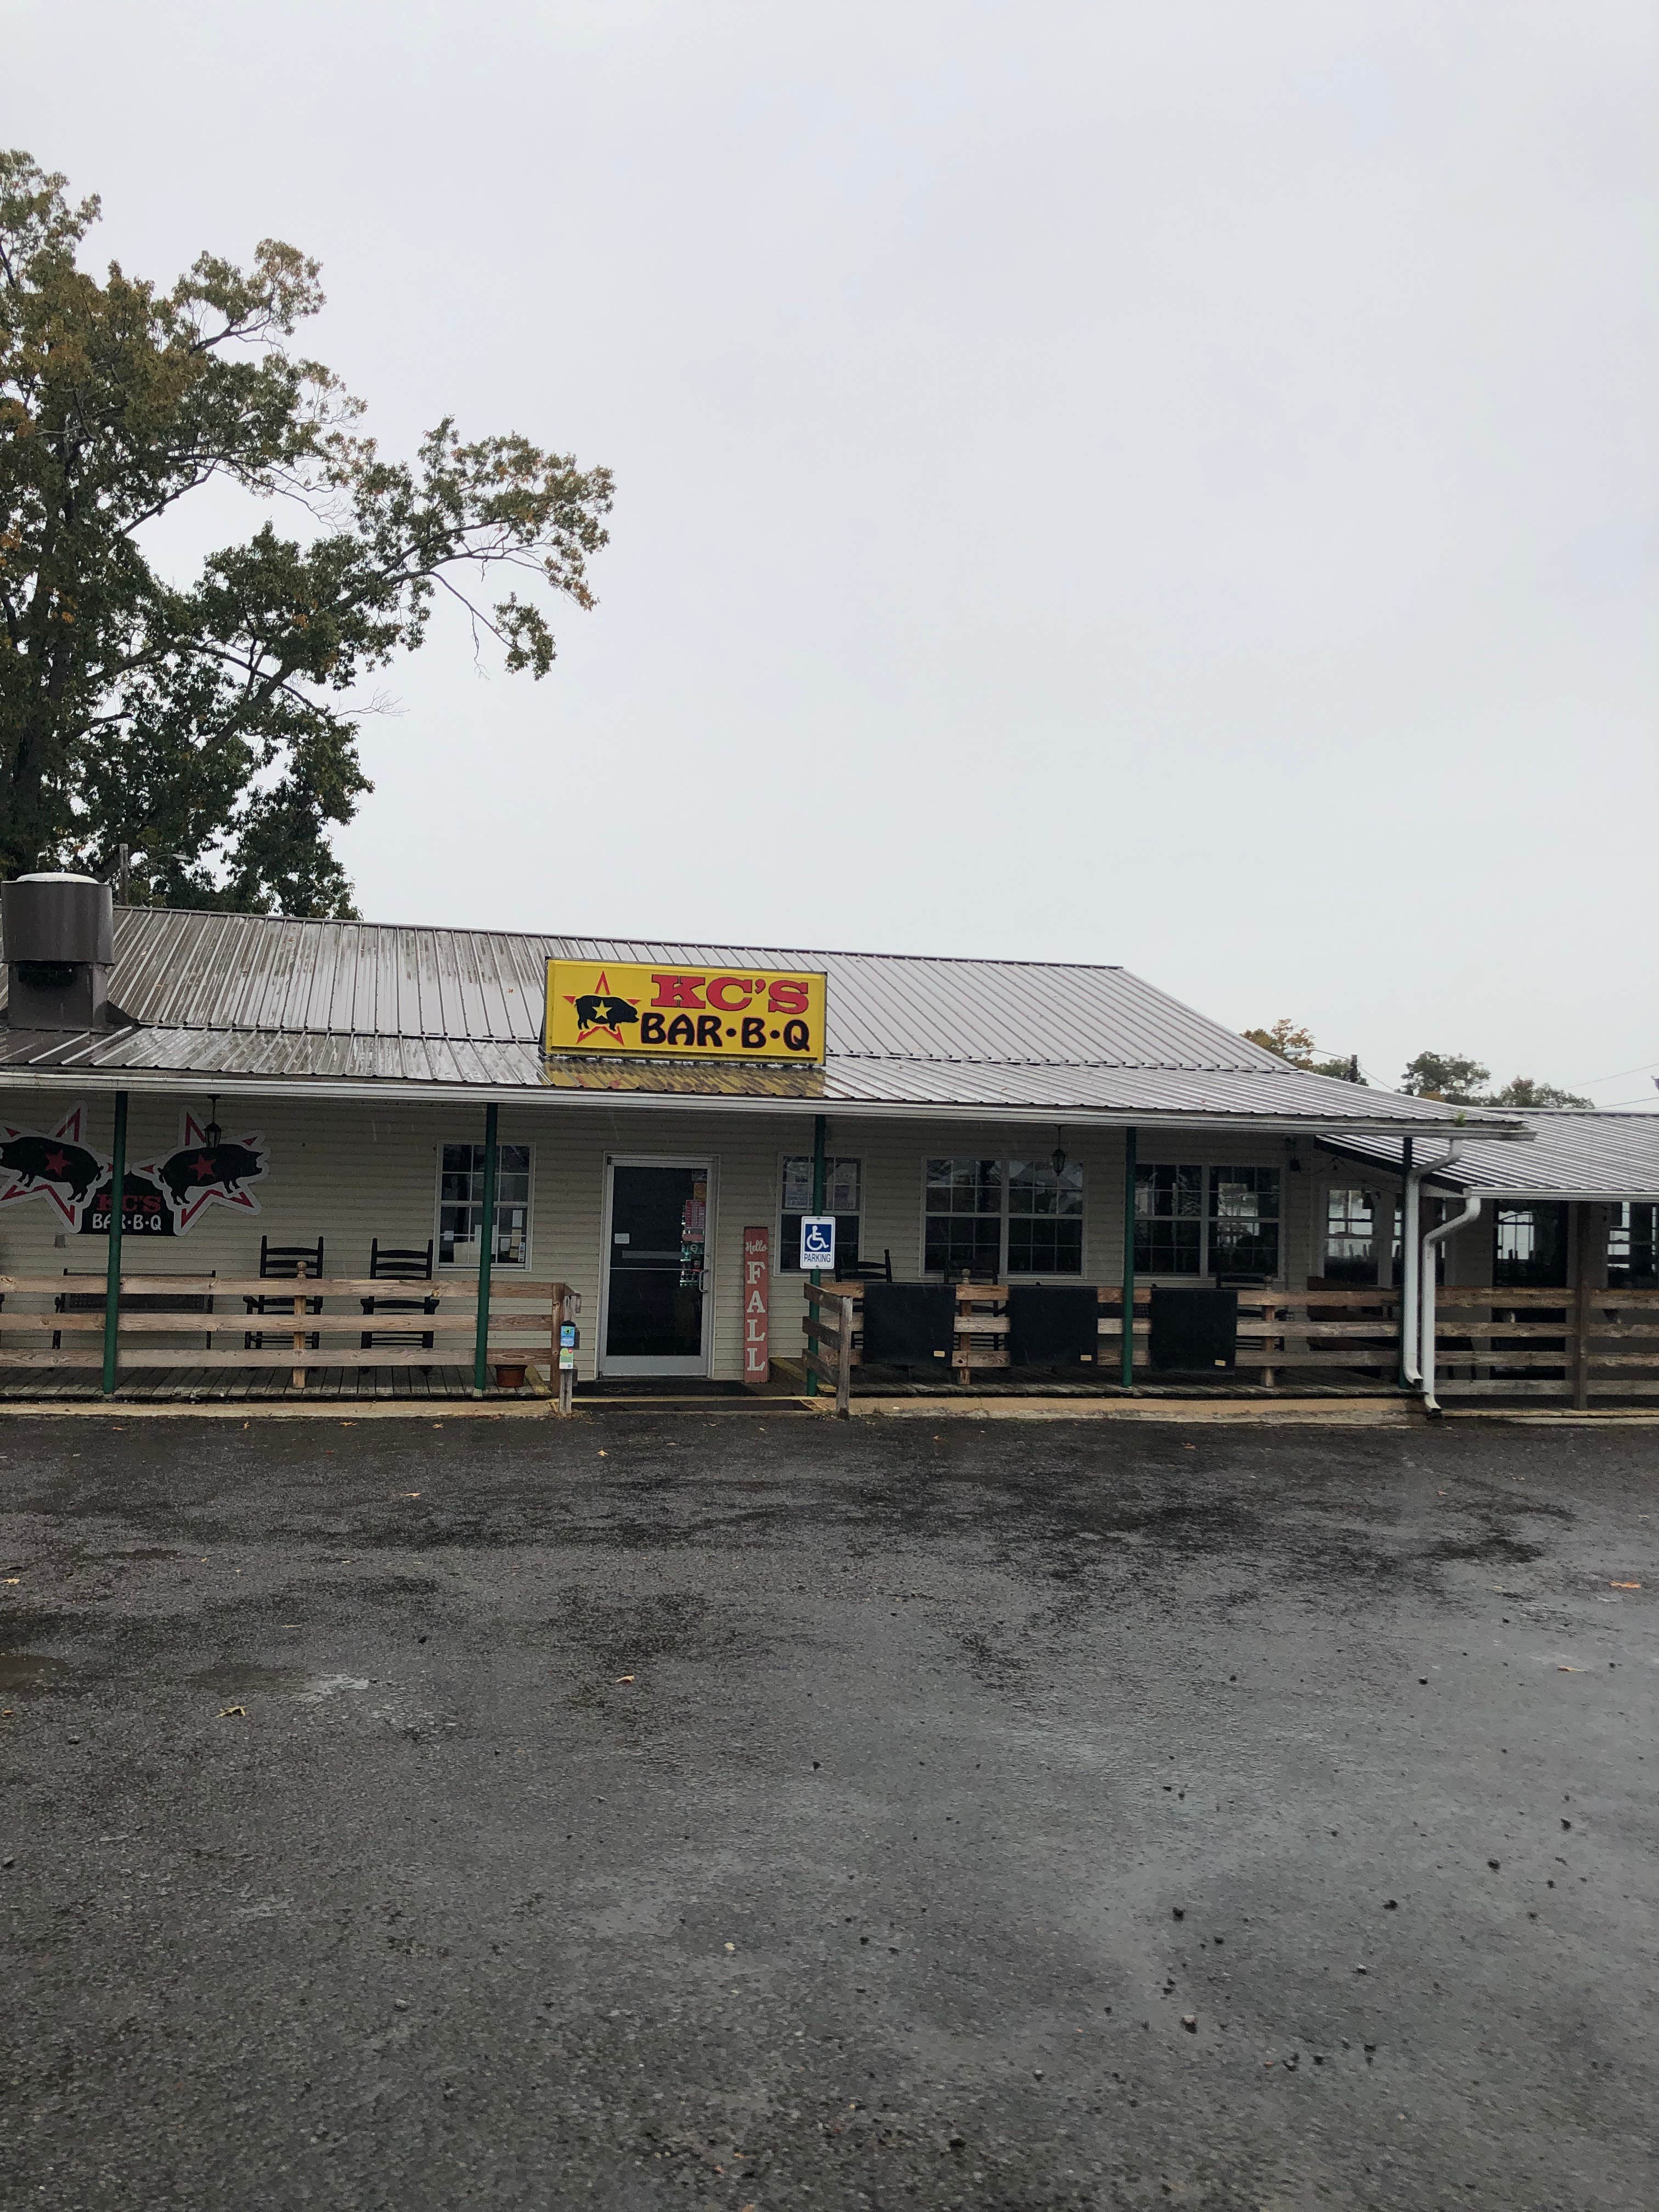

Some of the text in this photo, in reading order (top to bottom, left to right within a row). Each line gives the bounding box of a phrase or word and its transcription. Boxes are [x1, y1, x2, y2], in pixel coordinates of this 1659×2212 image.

[651, 974, 809, 1014] KC'S
[745, 1240, 768, 1255] Hello
[804, 1252, 831, 1263] PARKING
[747, 1261, 766, 1371] FALL
